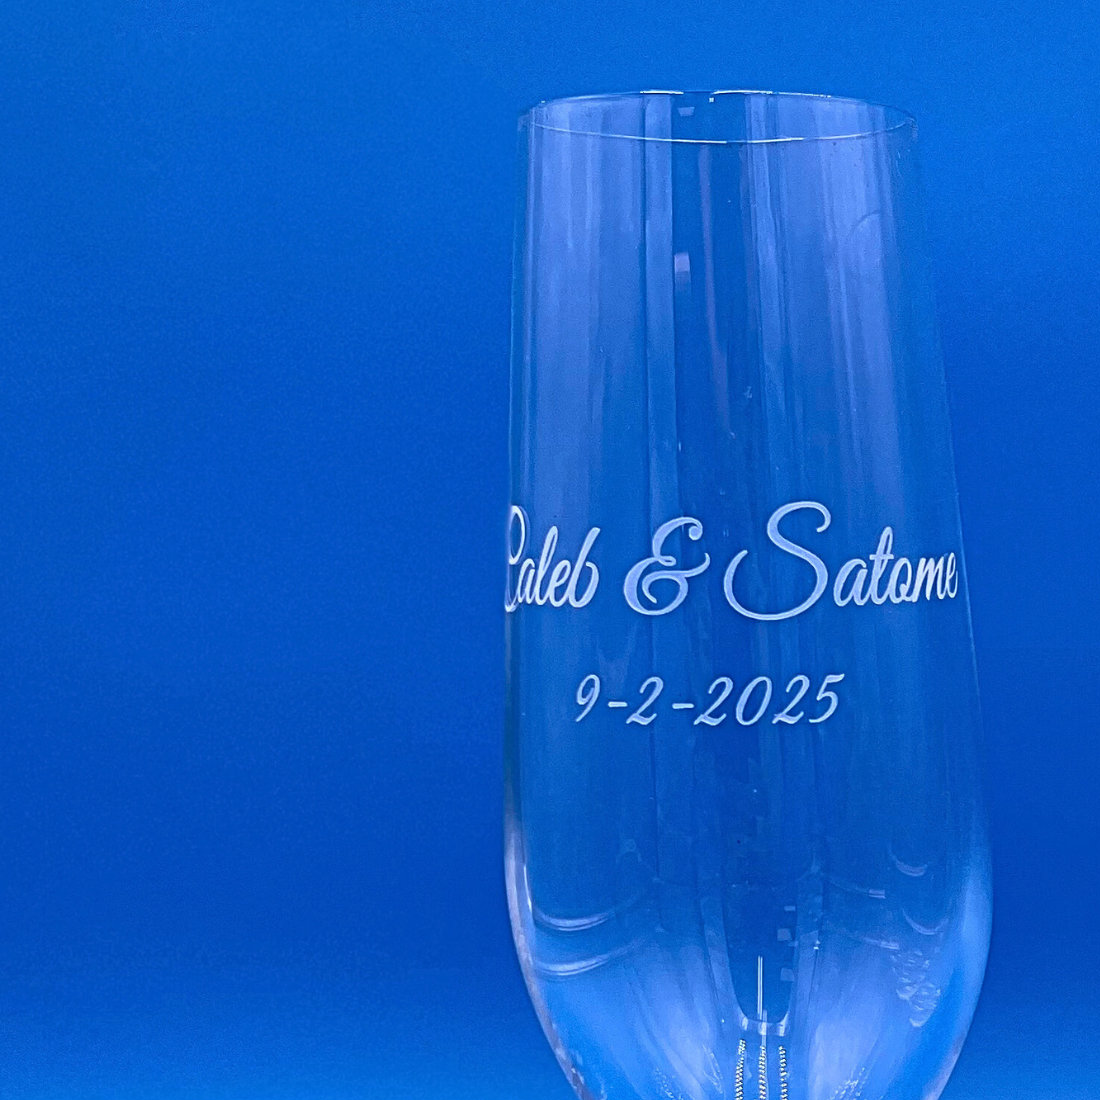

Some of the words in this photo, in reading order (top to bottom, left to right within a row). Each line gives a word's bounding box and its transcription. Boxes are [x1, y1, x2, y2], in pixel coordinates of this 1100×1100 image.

[623, 516, 711, 616] &
[723, 501, 959, 621] Satome
[574, 673, 845, 726] 9-2-2025
